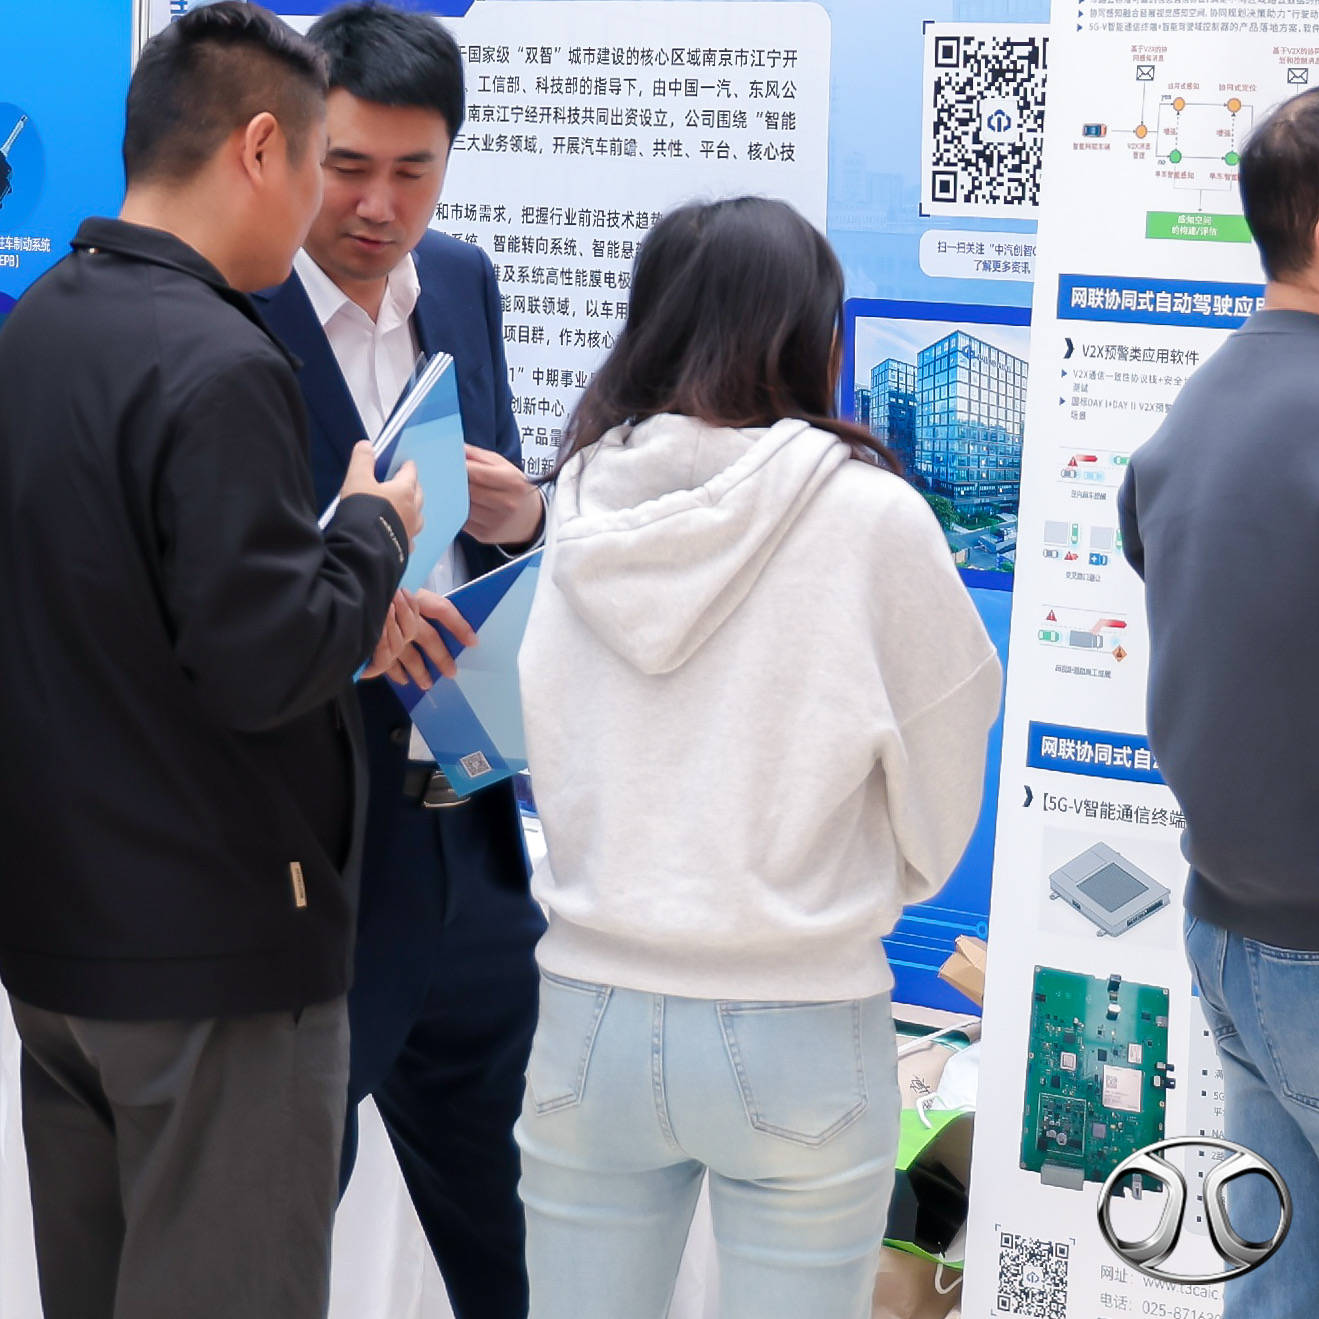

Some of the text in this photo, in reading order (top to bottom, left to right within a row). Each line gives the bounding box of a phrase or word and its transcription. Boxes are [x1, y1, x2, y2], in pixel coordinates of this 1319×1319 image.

[973, 259, 1031, 275] 了解更多资讯
[1082, 343, 1200, 366] V2X预警类应用软件
[509, 366, 596, 389] 1”中期事业
